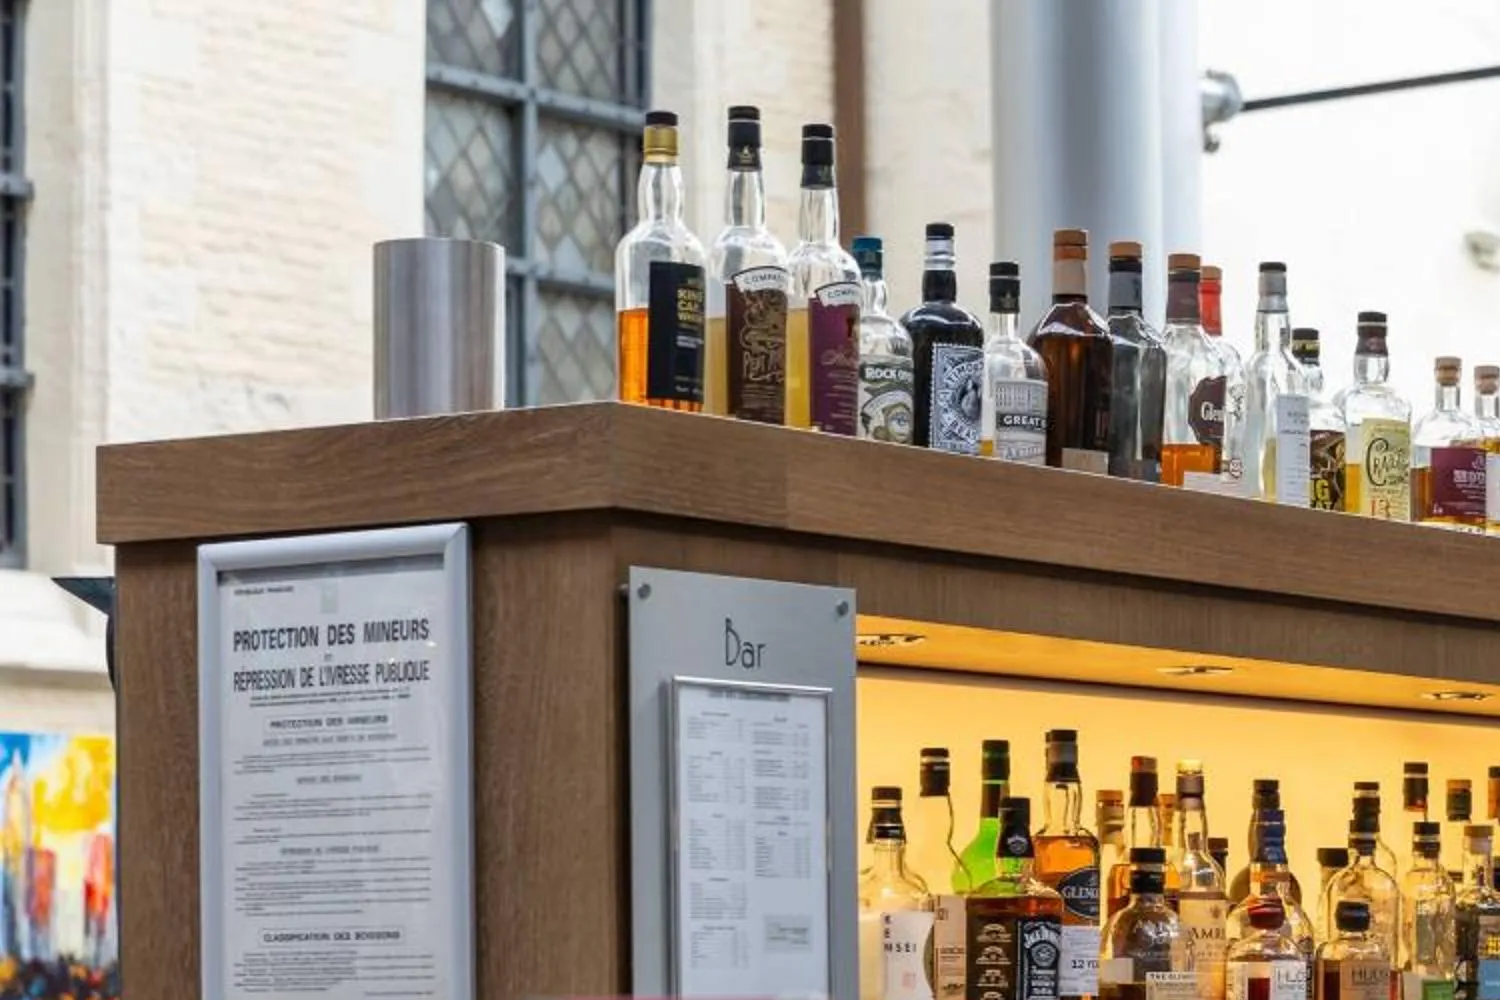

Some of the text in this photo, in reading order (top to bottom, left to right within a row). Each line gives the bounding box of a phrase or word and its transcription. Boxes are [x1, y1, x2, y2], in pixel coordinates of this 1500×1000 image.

[233, 618, 430, 652] PROTECTION DES MINEURS
[724, 616, 767, 670] Bar
[300, 667, 315, 689] DE
[319, 663, 371, 687] L'IVRESSE
[375, 659, 431, 684] PUBLIQUE
